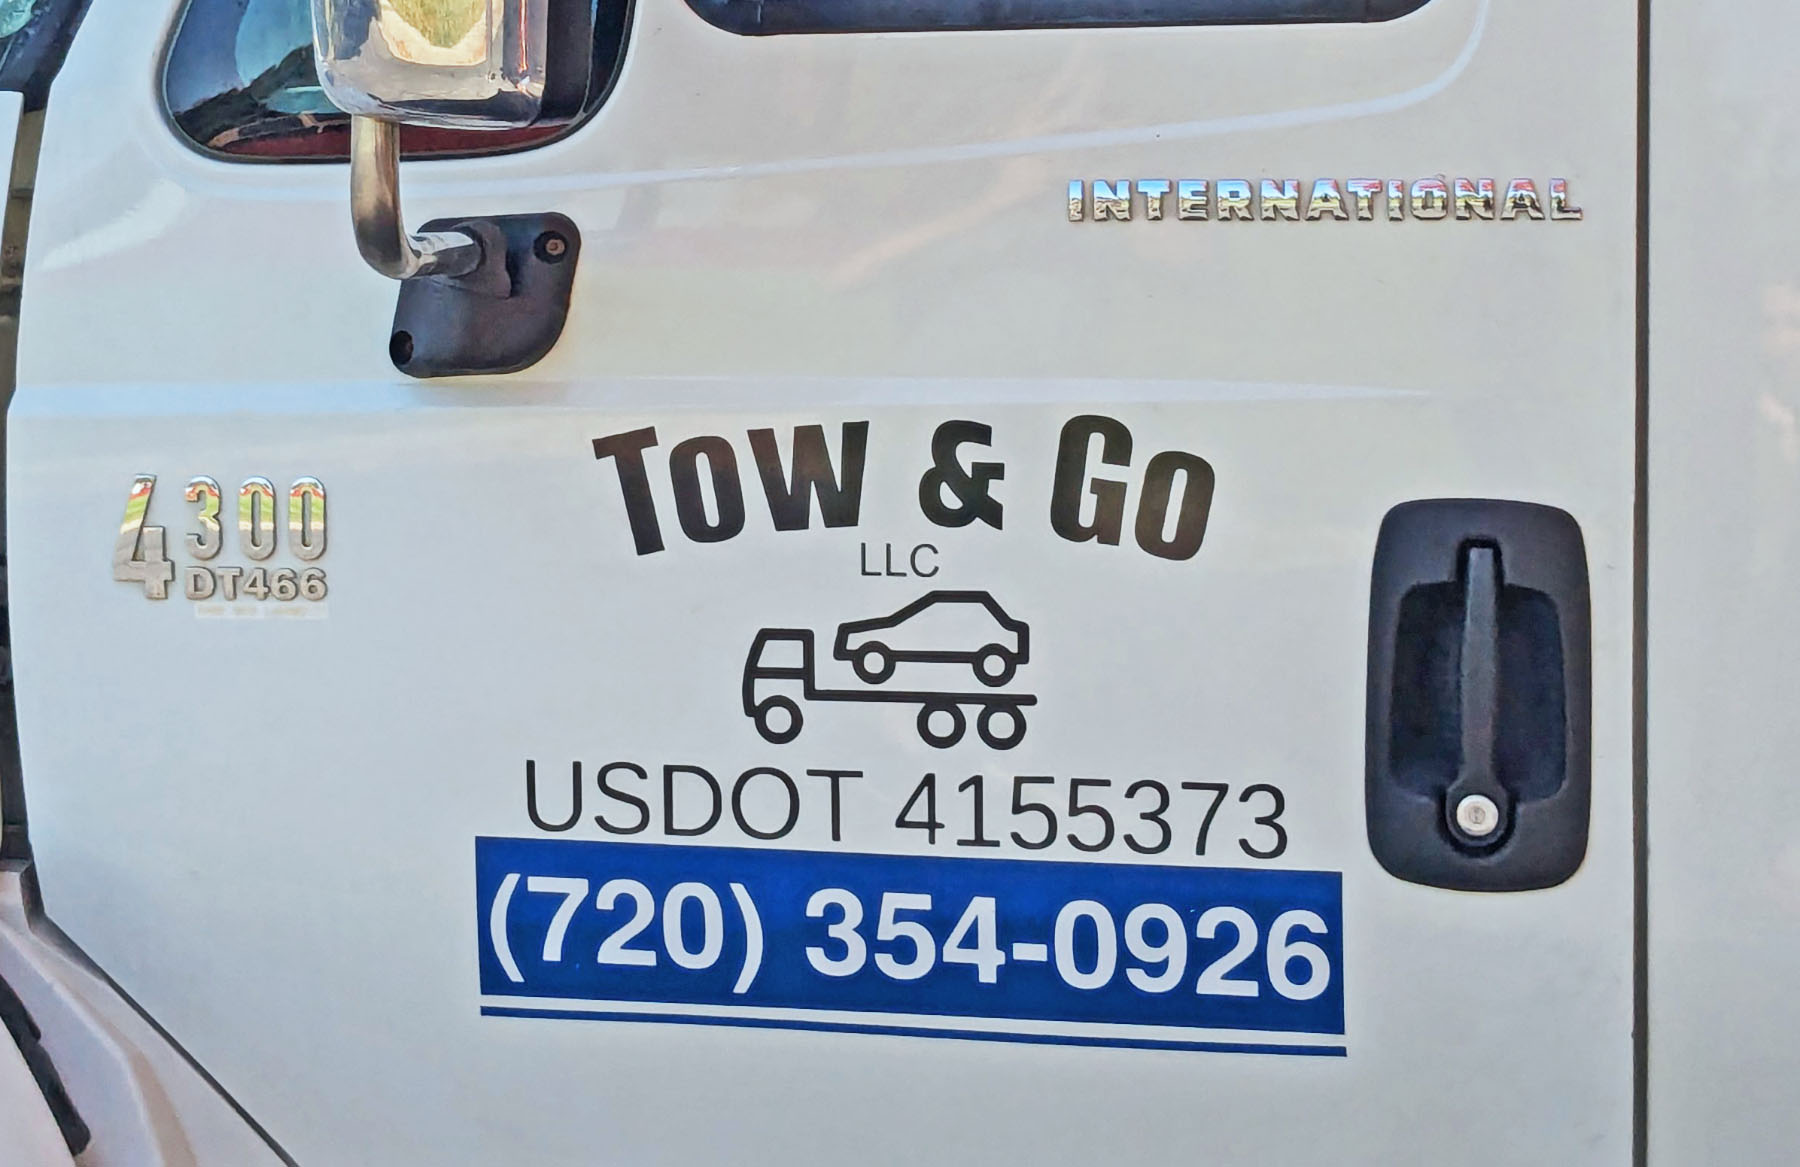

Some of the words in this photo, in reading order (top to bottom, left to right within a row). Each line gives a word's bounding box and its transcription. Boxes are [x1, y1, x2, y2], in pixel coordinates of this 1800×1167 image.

[1067, 178, 1584, 221] INTERNATIONAL
[918, 419, 1005, 531] &
[113, 473, 328, 600] 4300
[184, 566, 328, 601] DT466
[860, 542, 940, 578] LLC
[526, 759, 864, 841] USDOT
[894, 772, 1288, 859] 4155373
[490, 873, 764, 994] (720)
[805, 888, 1331, 1001] 354-0926
